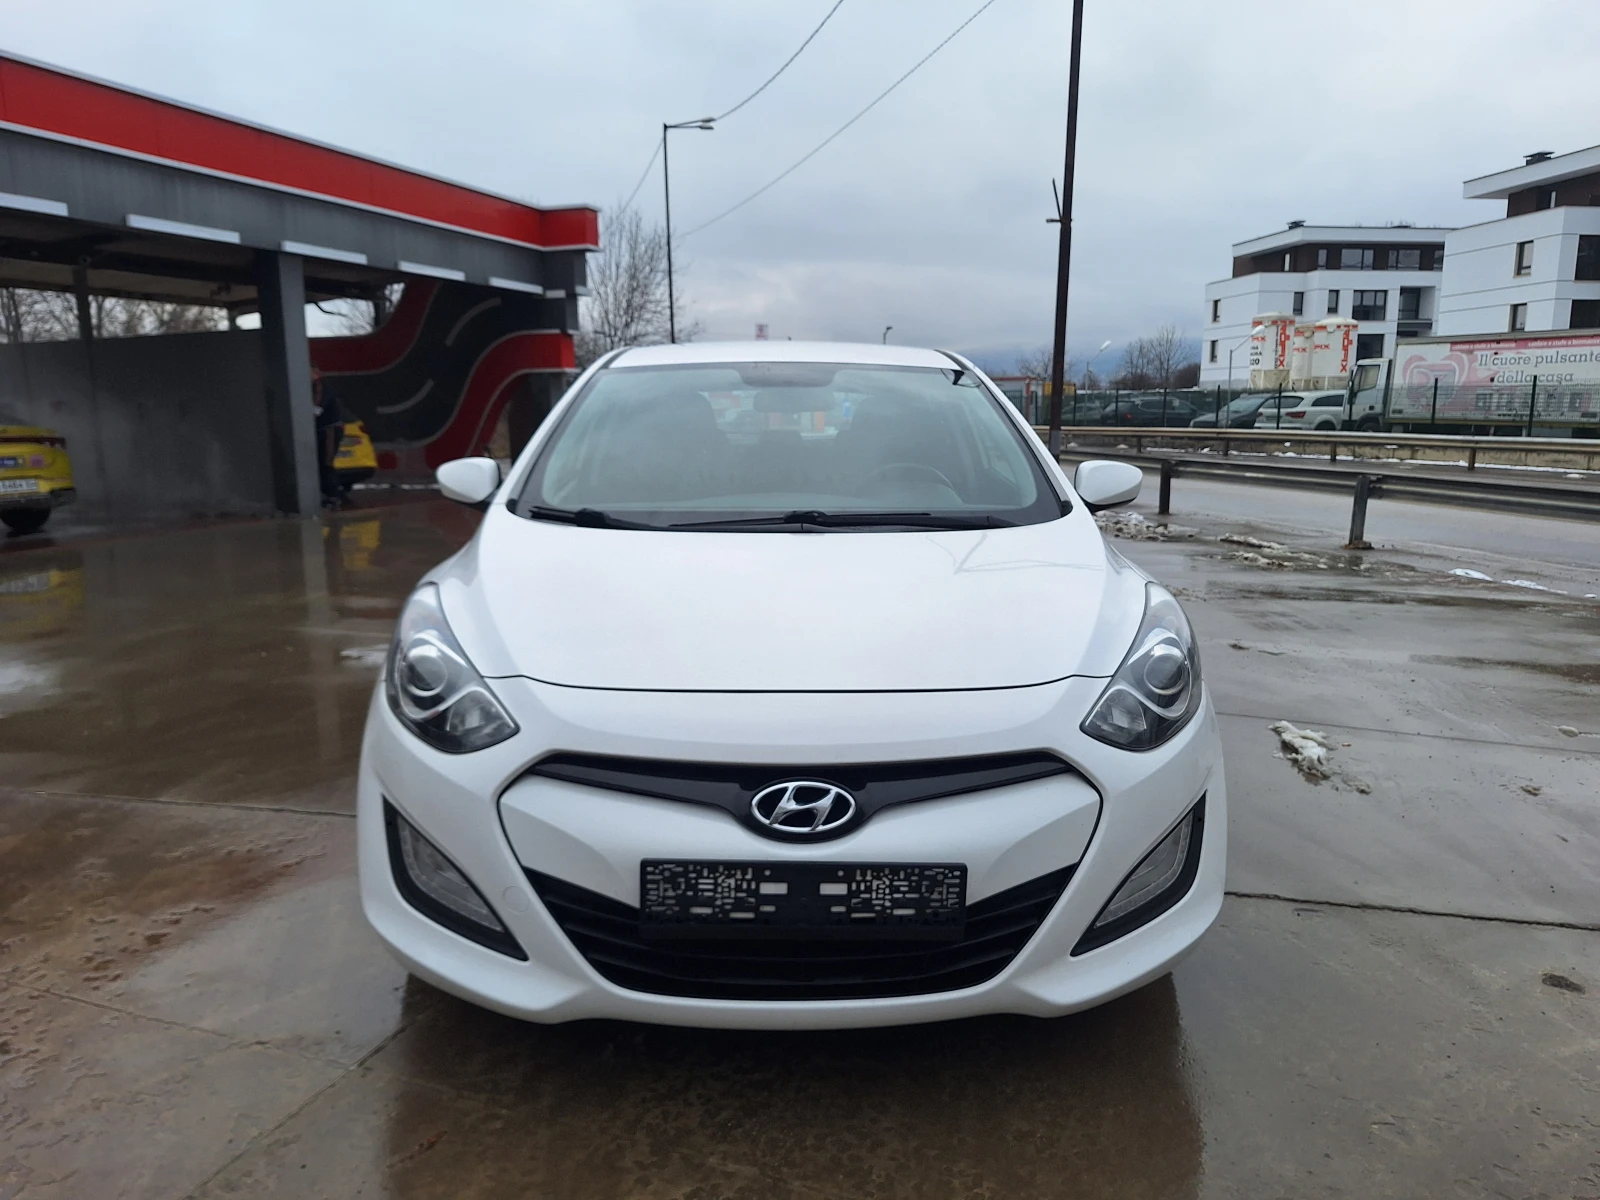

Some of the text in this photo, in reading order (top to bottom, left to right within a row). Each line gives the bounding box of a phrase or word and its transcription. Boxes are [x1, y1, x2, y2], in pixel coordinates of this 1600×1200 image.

[1479, 350, 1600, 368] Il cuore pulsante
[1495, 370, 1574, 384] della casa
